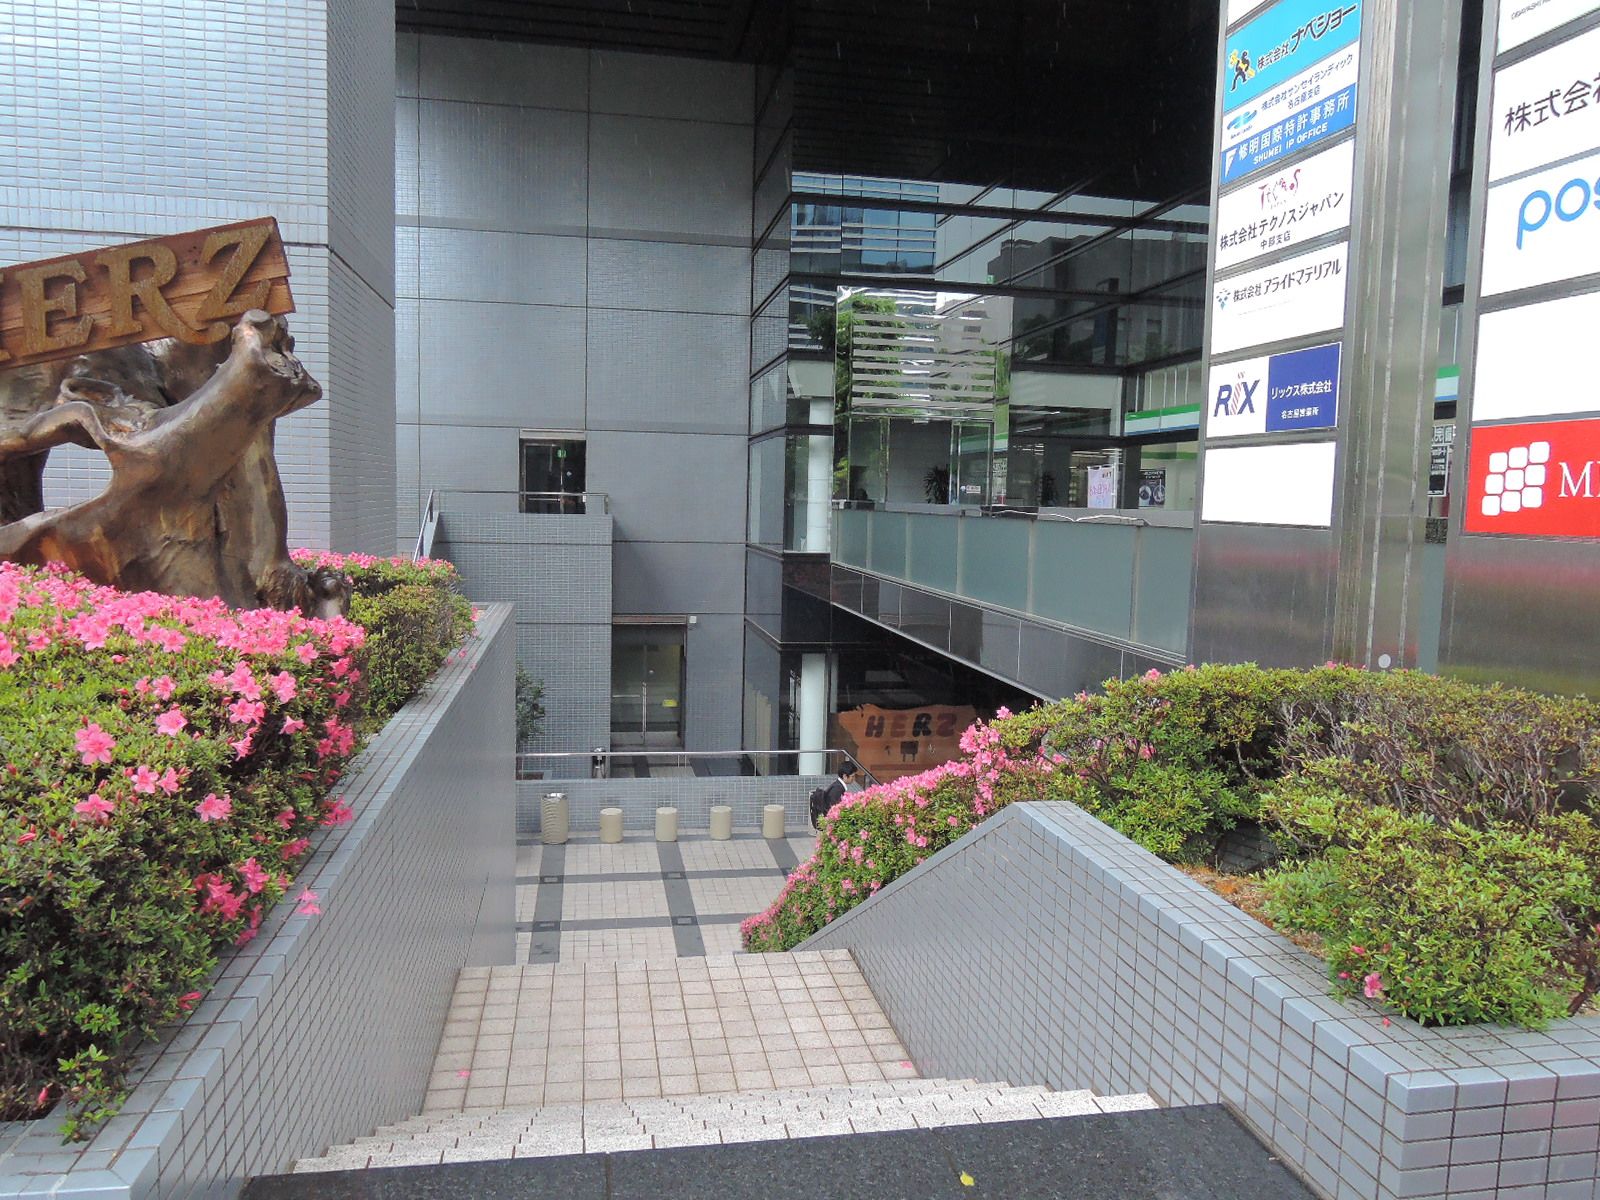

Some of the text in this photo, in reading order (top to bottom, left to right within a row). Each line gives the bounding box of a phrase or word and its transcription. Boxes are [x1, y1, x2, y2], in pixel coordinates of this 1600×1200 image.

[1238, 90, 1350, 161] 修明国際特許事務所
[1253, 122, 1328, 165] SHUMEI IP OFFICE
[1220, 192, 1344, 251] 株式会社テクノスジャパン
[1516, 177, 1600, 250] po
[0, 224, 274, 363] ERZ
[1271, 379, 1332, 400] リックス株式会社
[1558, 461, 1600, 498] M
[865, 712, 957, 738] HERZ
